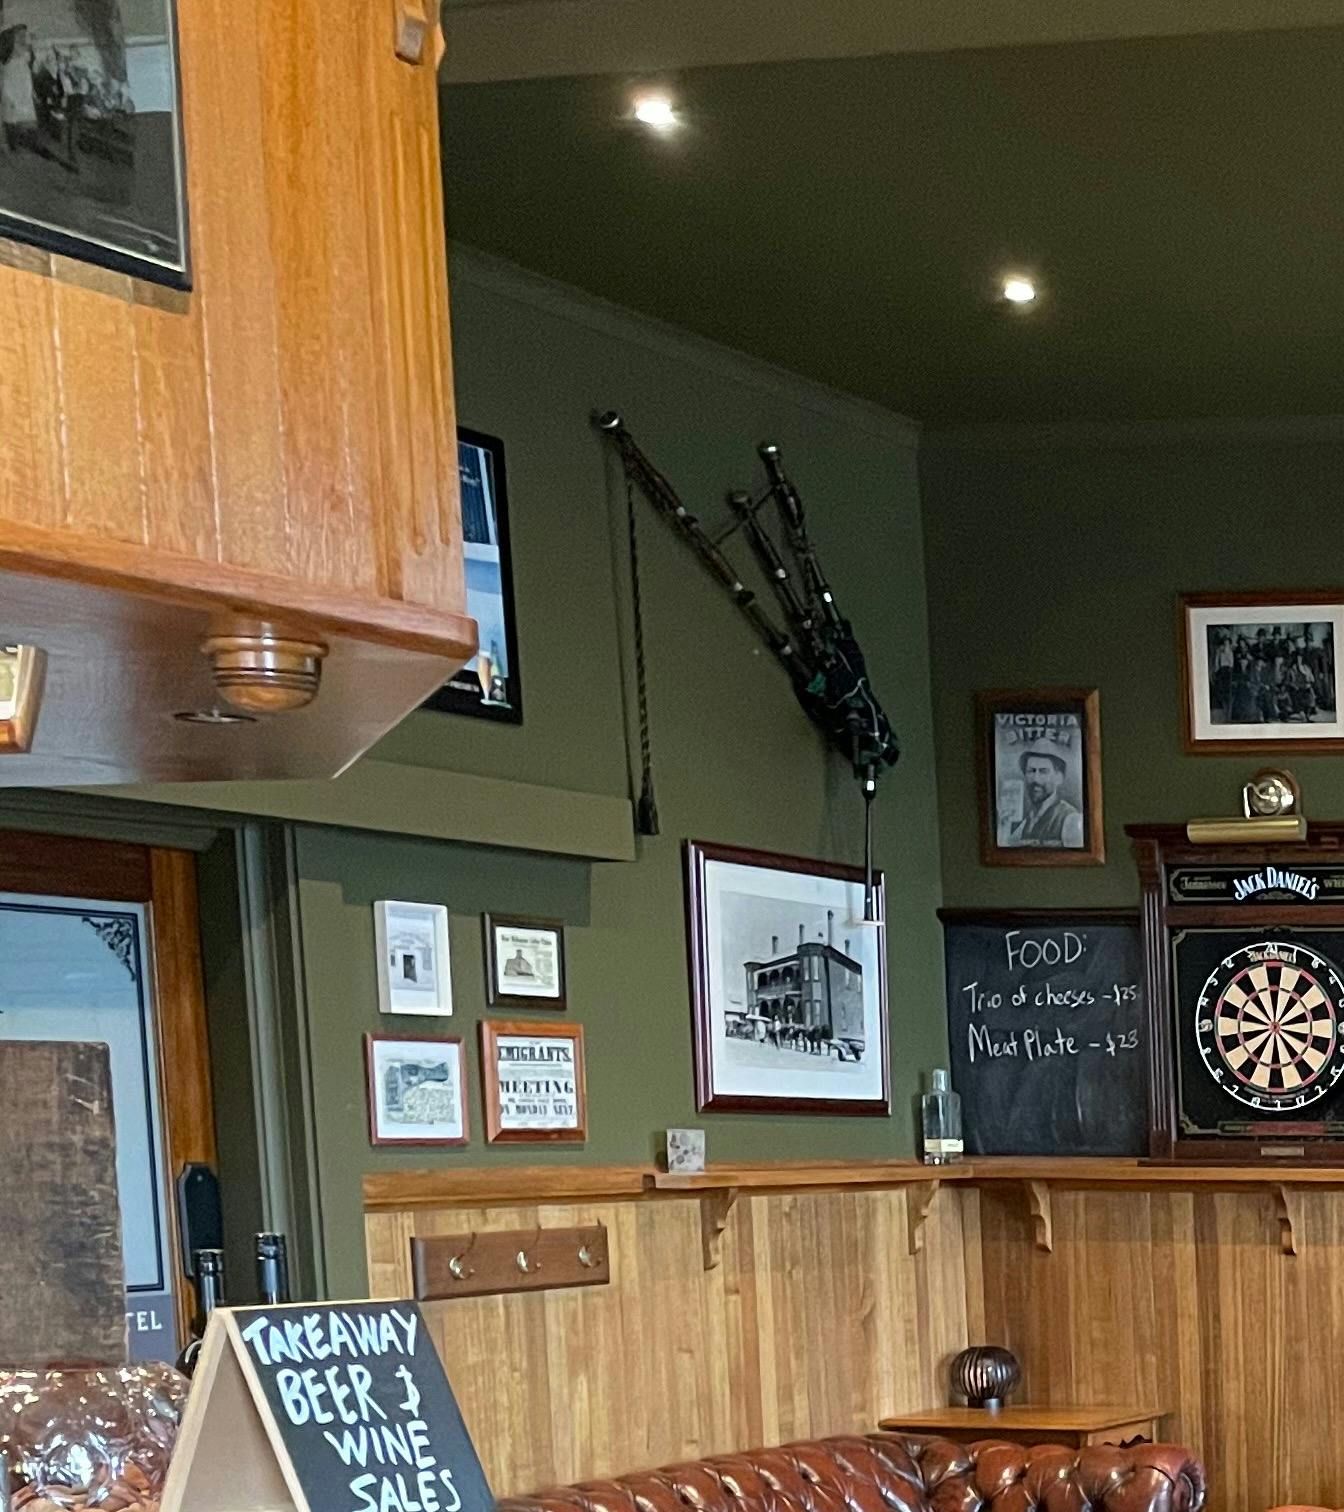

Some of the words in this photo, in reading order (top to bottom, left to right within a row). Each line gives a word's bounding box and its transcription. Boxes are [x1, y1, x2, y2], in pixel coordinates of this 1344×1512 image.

[995, 713, 1080, 725] VICTORIA
[1005, 726, 1071, 744] BITTER
[1232, 871, 1267, 901] JACK
[1265, 866, 1320, 901] DANIEL'S
[1005, 930, 1087, 972] FOOD:
[962, 981, 1002, 1014] Trio
[1011, 984, 1027, 1007] of
[1034, 982, 1096, 1008] cheeses
[967, 1022, 1019, 1063] Meat
[1023, 1026, 1080, 1062] Plate
[500, 1080, 574, 1094] MEETING
[241, 1308, 418, 1366] TAKEAWAY
[275, 1363, 388, 1426] BEER
[322, 1419, 437, 1470] WINE
